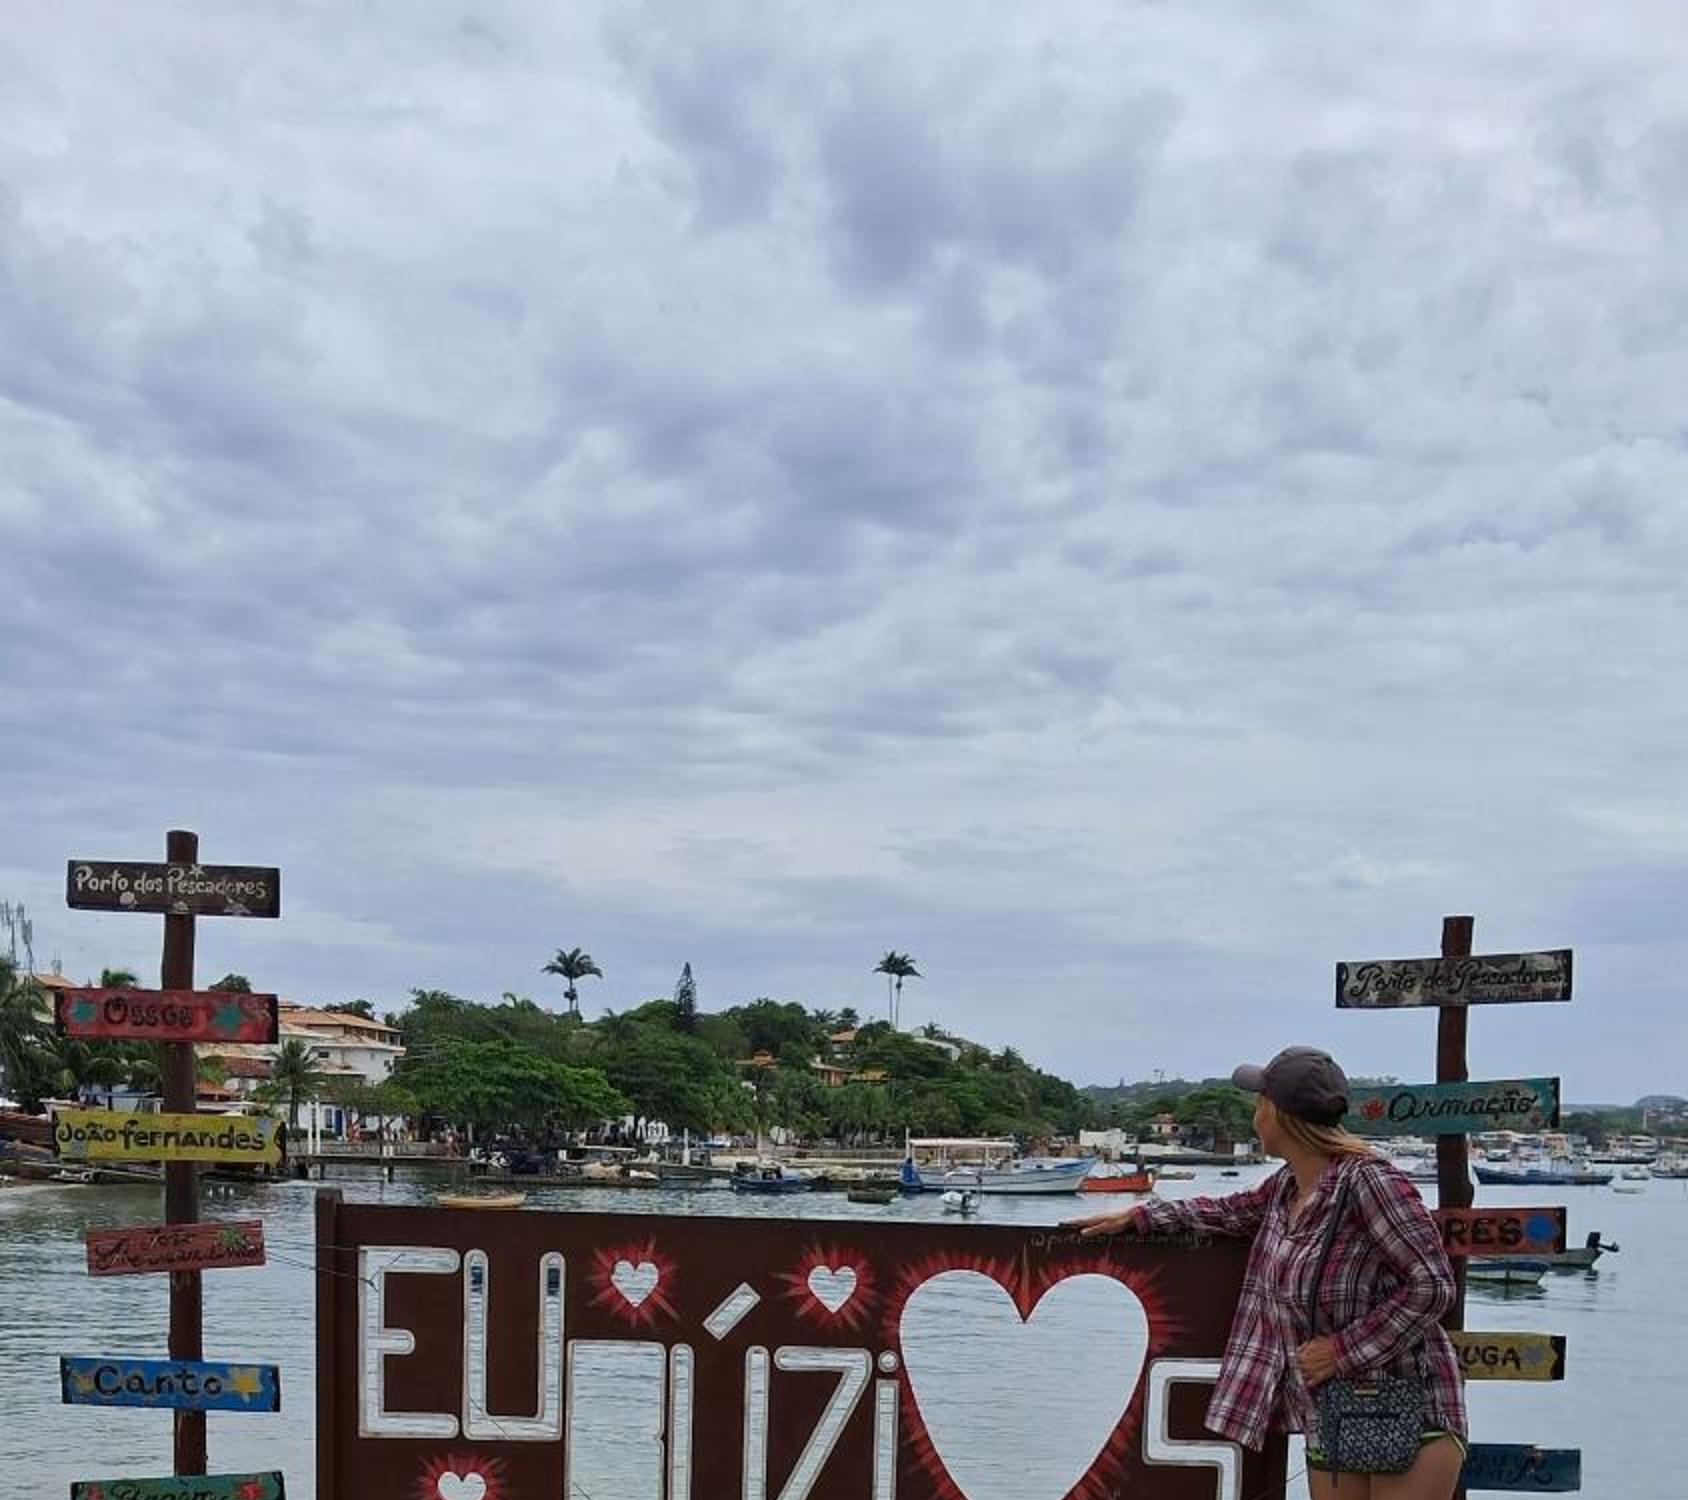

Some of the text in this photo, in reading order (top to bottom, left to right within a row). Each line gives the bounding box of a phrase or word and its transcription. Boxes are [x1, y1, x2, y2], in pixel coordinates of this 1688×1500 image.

[75, 865, 267, 898] Porto dos Pescadores
[1443, 1216, 1523, 1247] RES
[358, 1245, 566, 1440] EU
[93, 1365, 224, 1396] Canto
